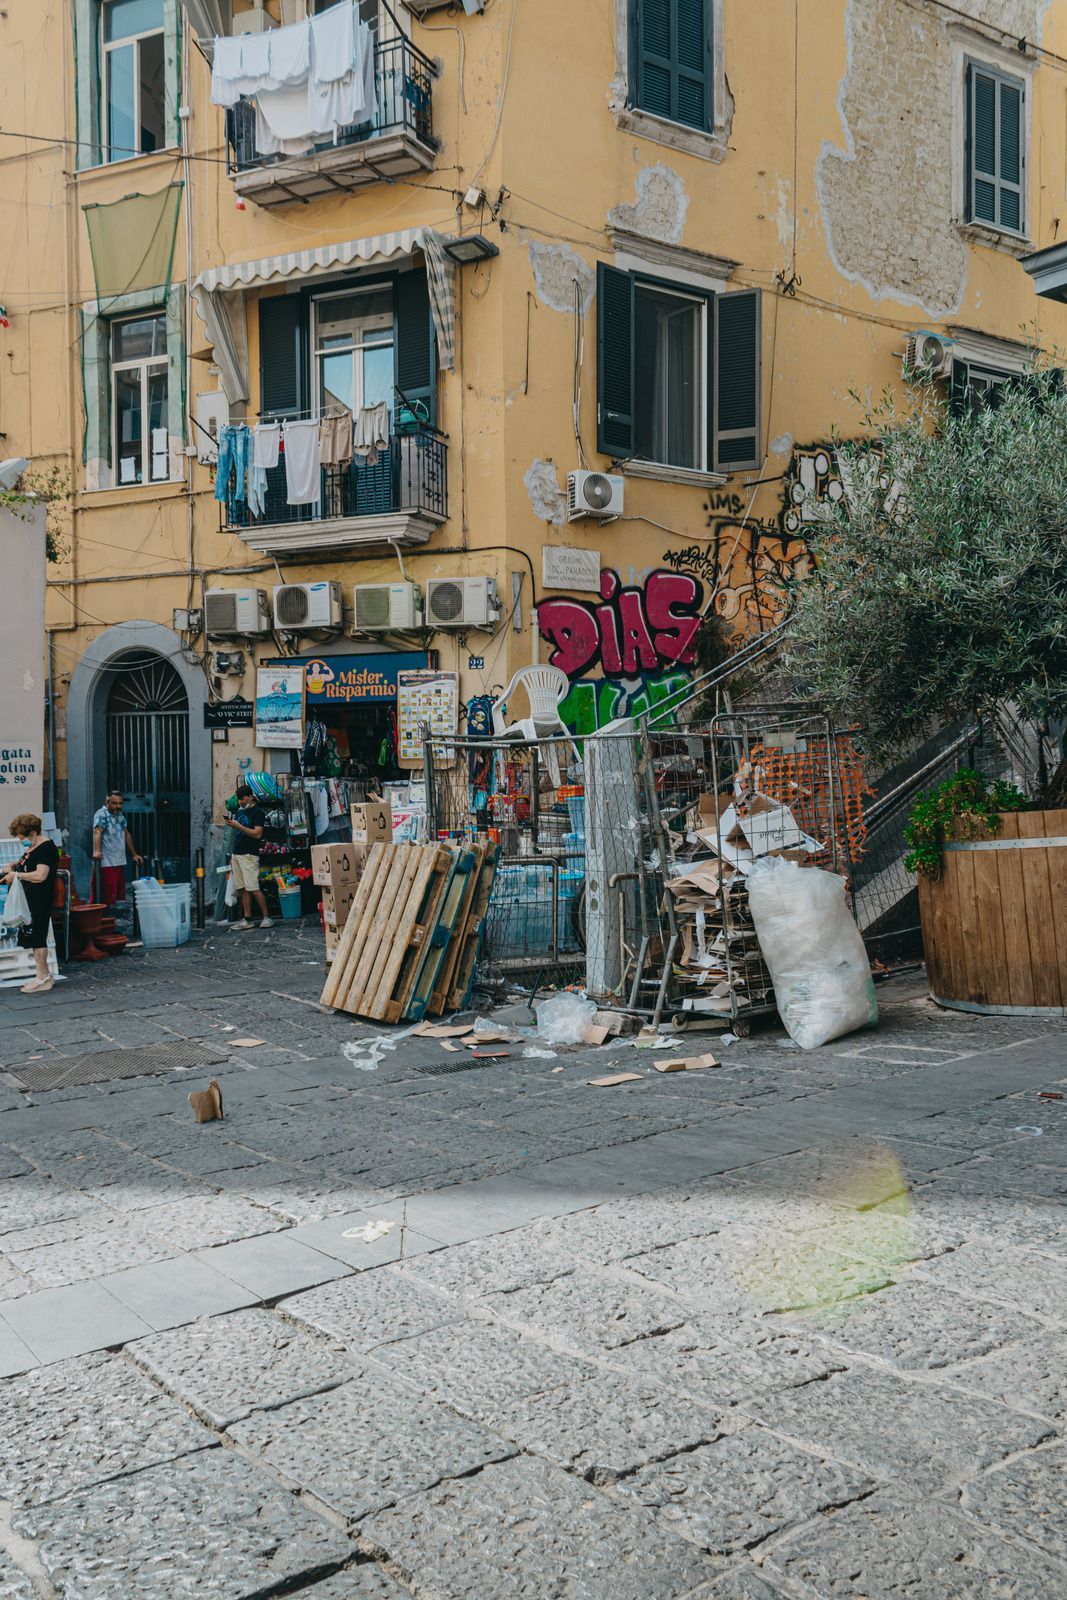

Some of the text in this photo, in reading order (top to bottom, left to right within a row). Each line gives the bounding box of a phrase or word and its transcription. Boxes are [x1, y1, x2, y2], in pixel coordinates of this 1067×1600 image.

[470, 658, 483, 669] 22
[339, 667, 384, 685] Mister
[325, 679, 397, 702] Risparmio
